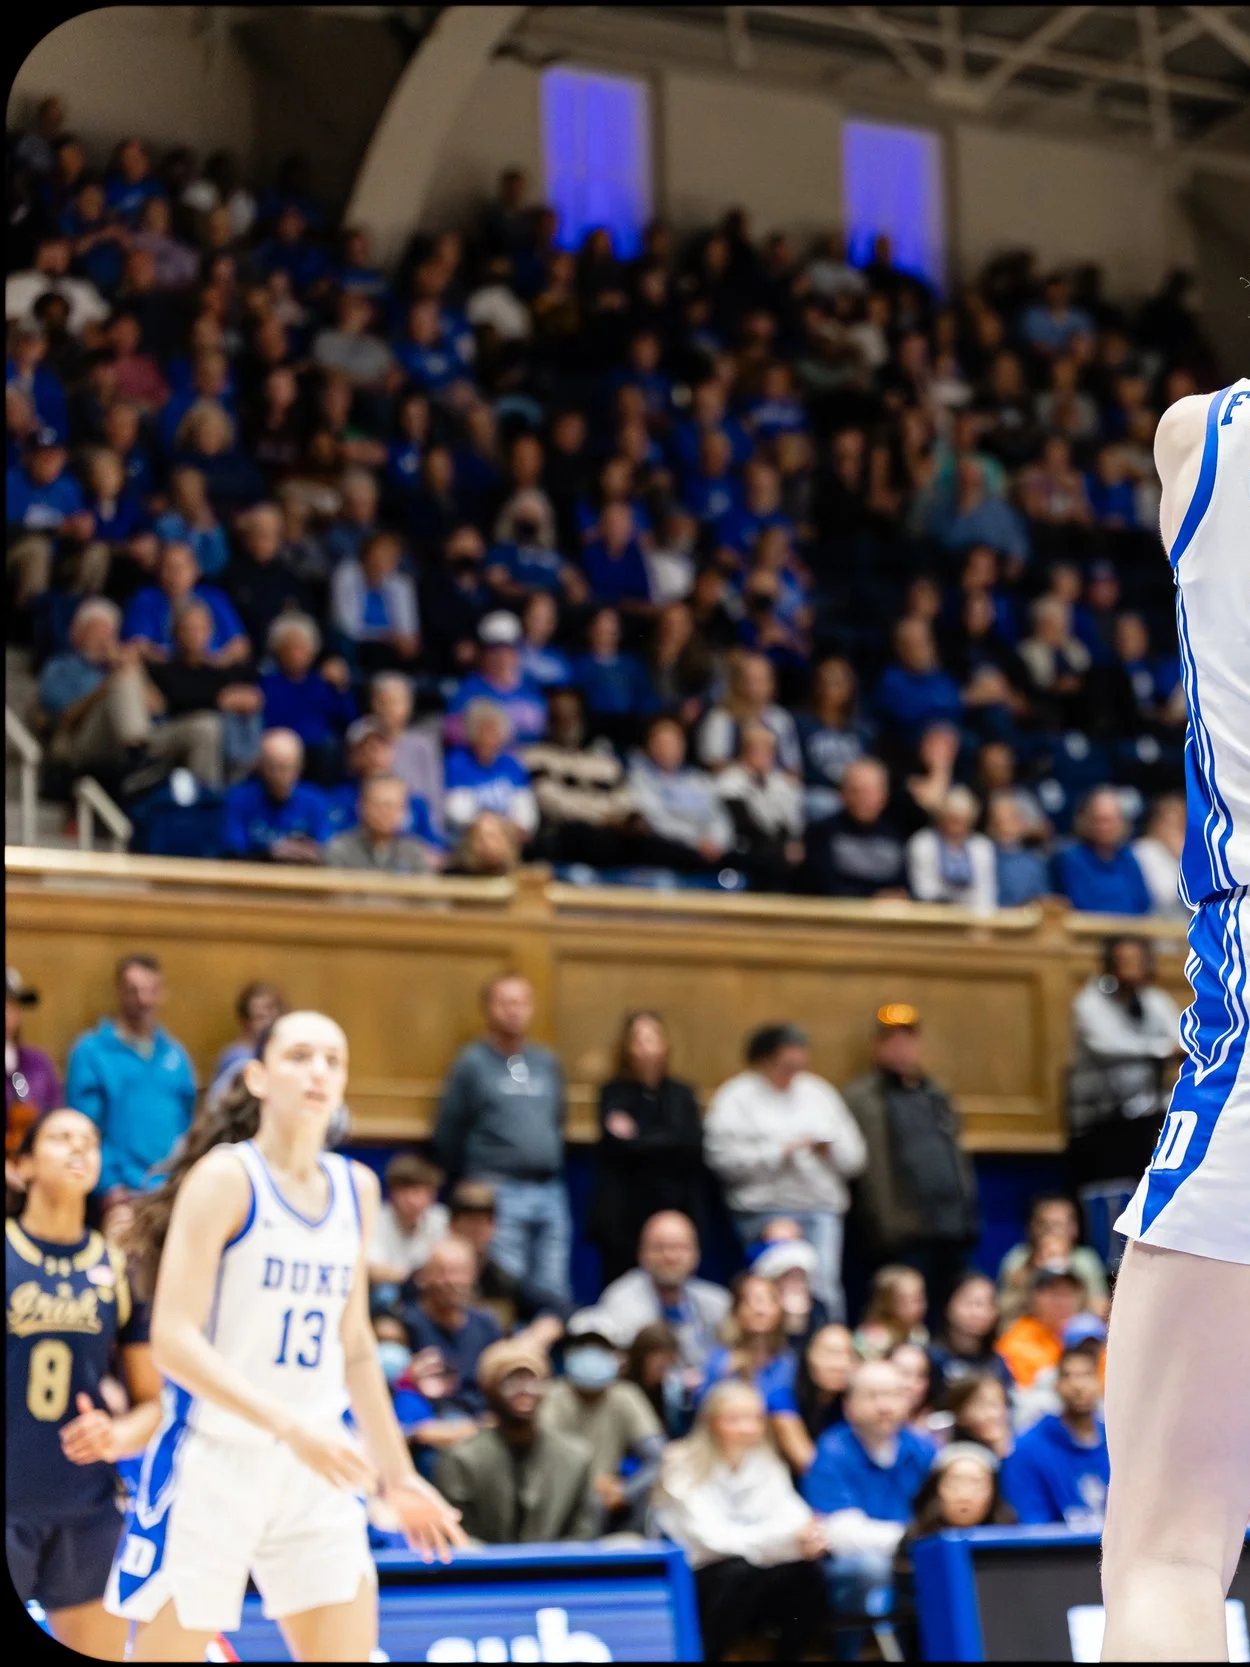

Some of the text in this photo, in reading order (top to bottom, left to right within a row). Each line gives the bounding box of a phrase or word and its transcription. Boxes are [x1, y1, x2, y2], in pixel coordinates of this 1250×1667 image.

[1152, 1111, 1198, 1171] D
[274, 1308, 326, 1368] 13
[27, 1340, 73, 1422] 8
[119, 1532, 158, 1579] D
